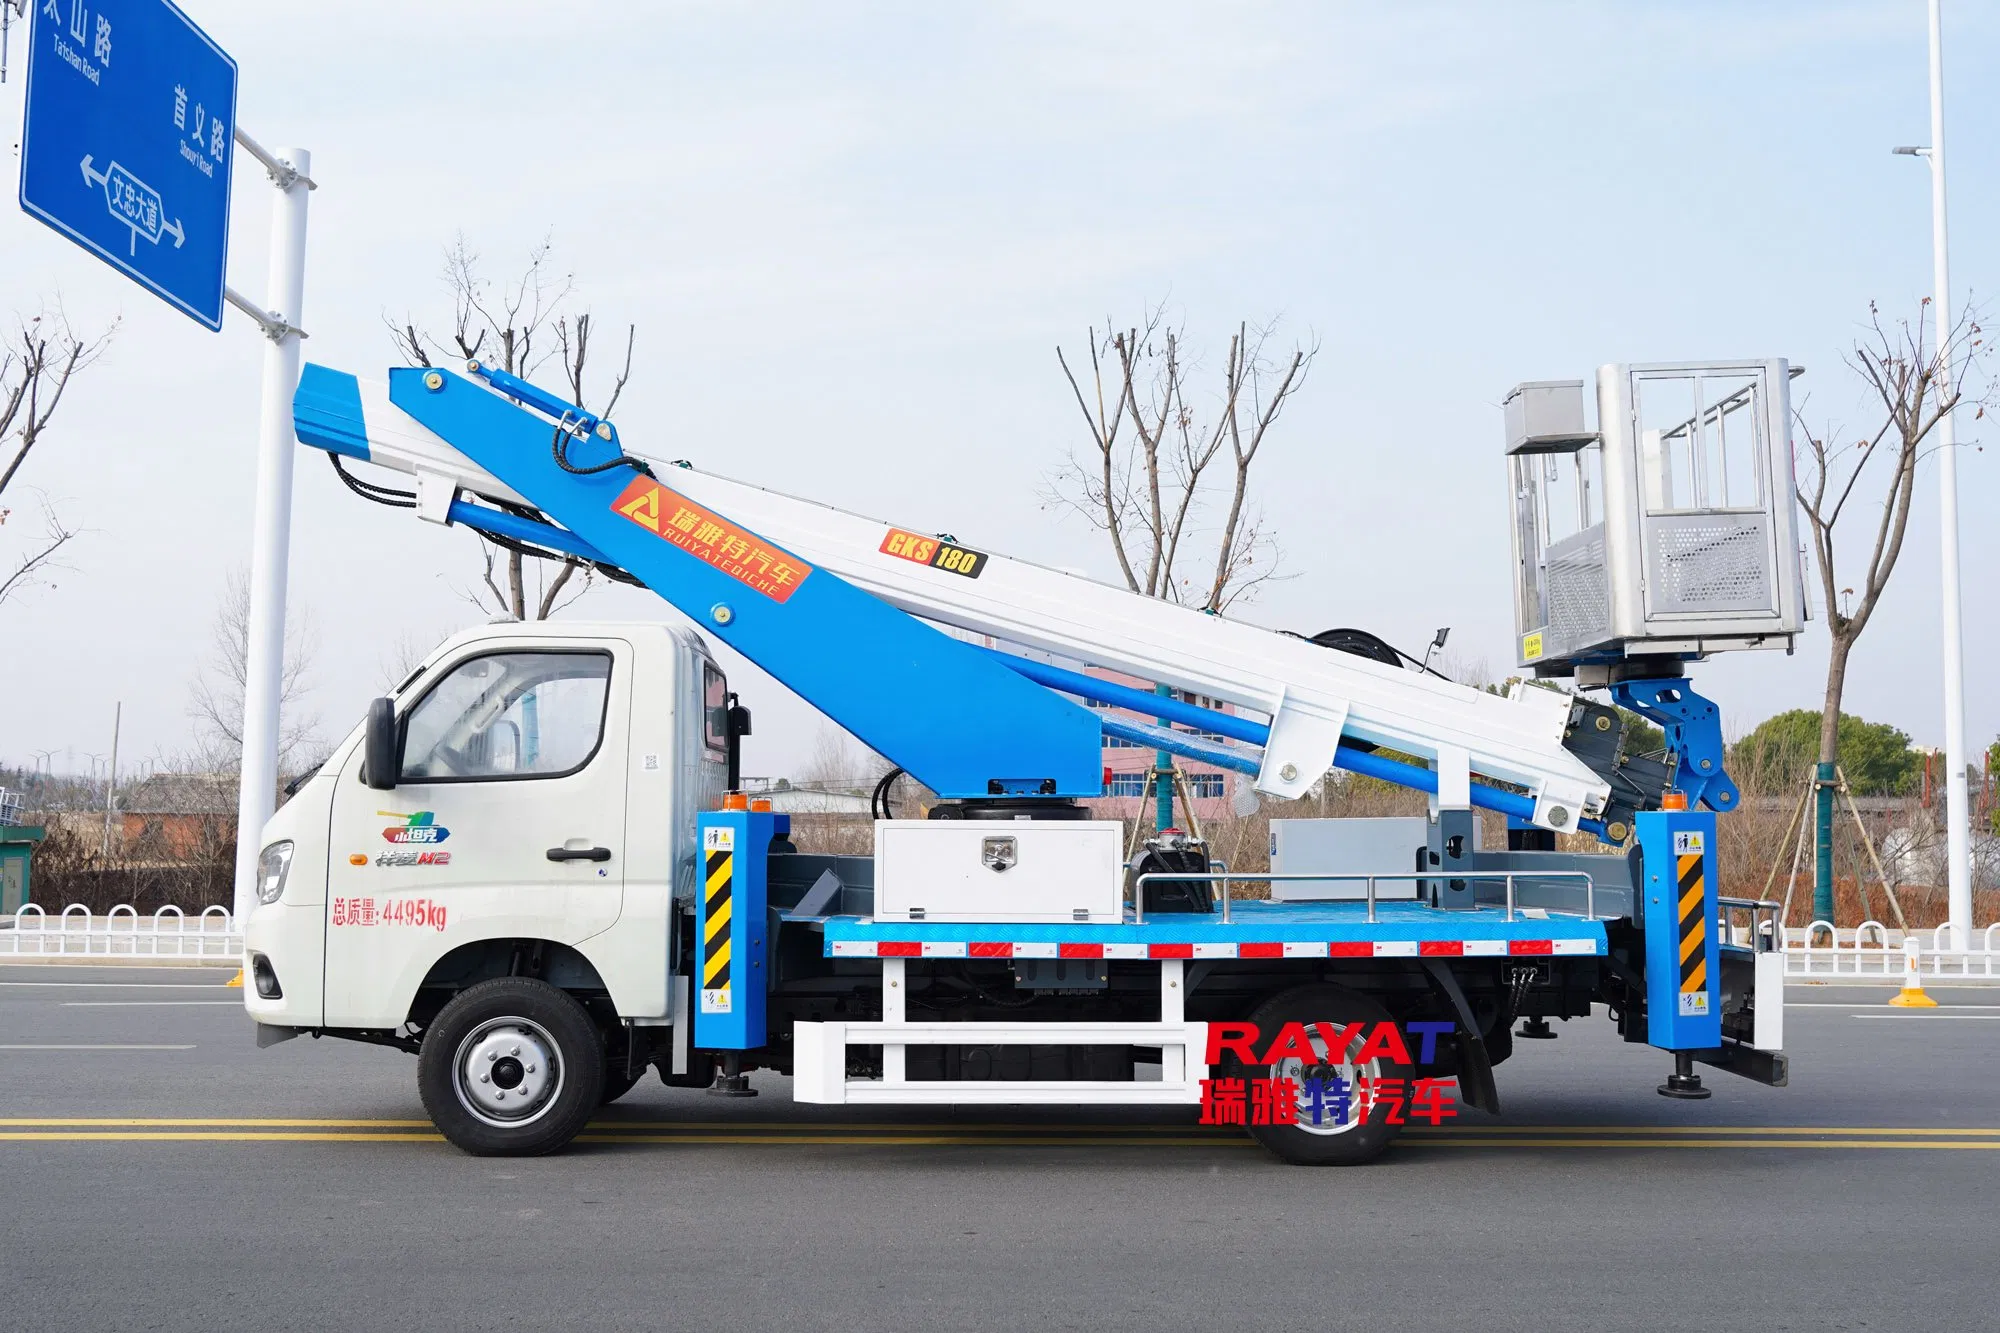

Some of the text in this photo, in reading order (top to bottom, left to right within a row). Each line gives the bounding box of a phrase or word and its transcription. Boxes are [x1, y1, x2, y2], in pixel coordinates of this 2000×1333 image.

[54, 33, 100, 86] Taishan Road
[174, 83, 225, 164] 首义路
[200, 154, 213, 178] Road
[112, 174, 158, 235] 文忠大道
[663, 528, 780, 596] RUIYATEQICHE
[667, 507, 801, 586] 瑞雅特汽车
[887, 533, 978, 574] GKS 180
[394, 827, 438, 842] 小坦克
